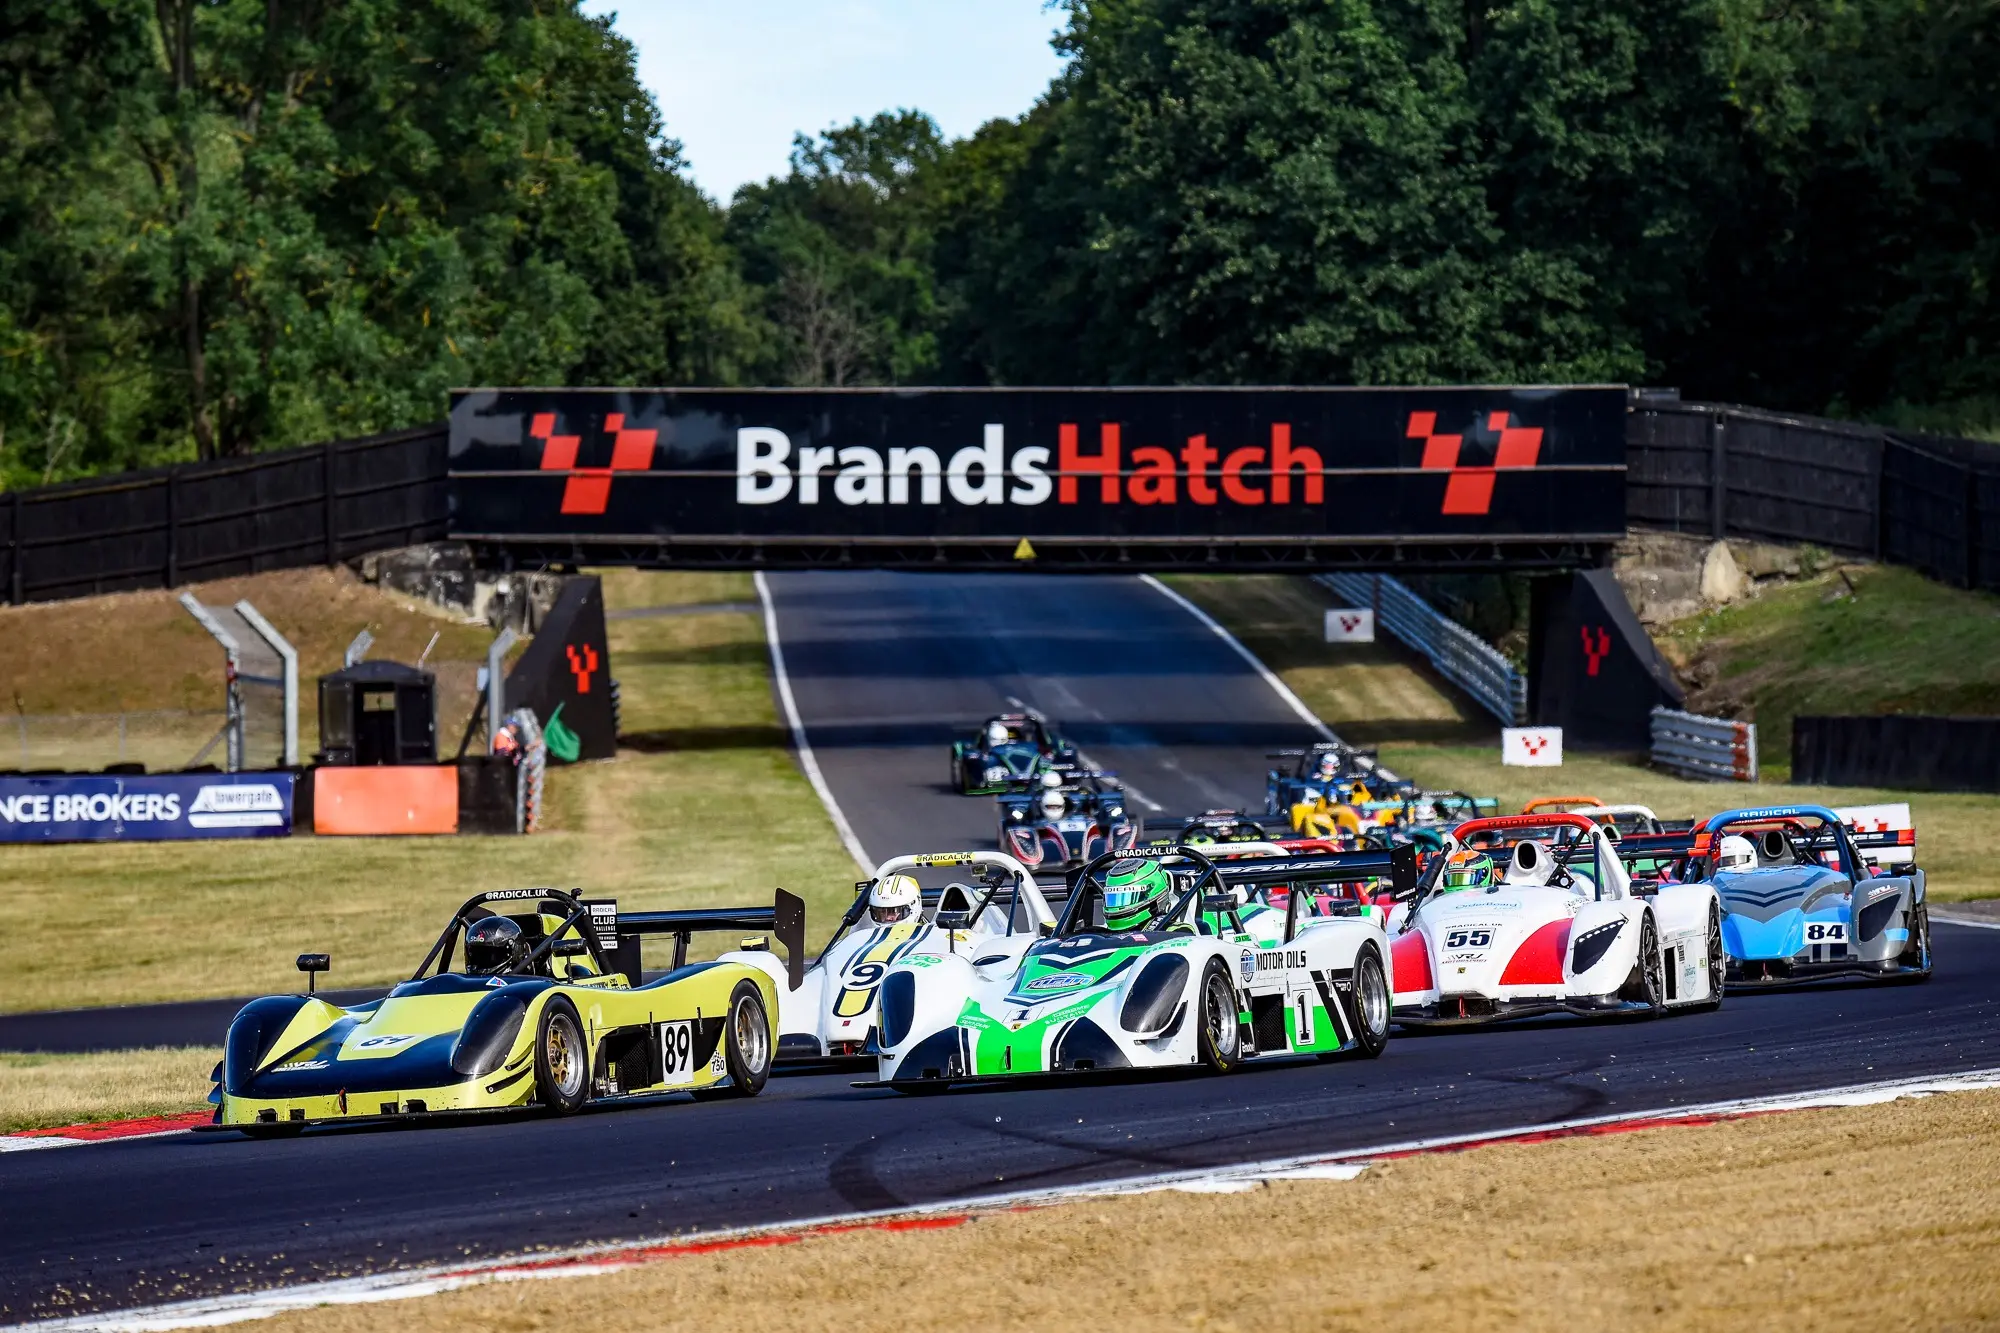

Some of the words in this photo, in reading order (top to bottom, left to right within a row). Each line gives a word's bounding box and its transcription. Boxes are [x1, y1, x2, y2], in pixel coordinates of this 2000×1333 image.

[53, 794, 180, 821] BROKERS
[1739, 808, 1800, 818] RADICAL
[1487, 818, 1552, 828] RADICAL
[916, 852, 972, 862] @RADICAL.UK
[1114, 846, 1180, 858] @RADICAL.UK
[486, 889, 549, 900] @RADICAL.UK
[592, 916, 616, 925] CLUB
[1446, 930, 1491, 948] 55
[1807, 924, 1845, 940] 84
[1255, 952, 1284, 971] MOTOR
[1286, 950, 1306, 969] OILS
[848, 964, 884, 987] 9
[1012, 1009, 1030, 1021] 1
[1297, 991, 1311, 1042] 1
[665, 1024, 690, 1075] 89
[711, 1058, 725, 1073] 750
